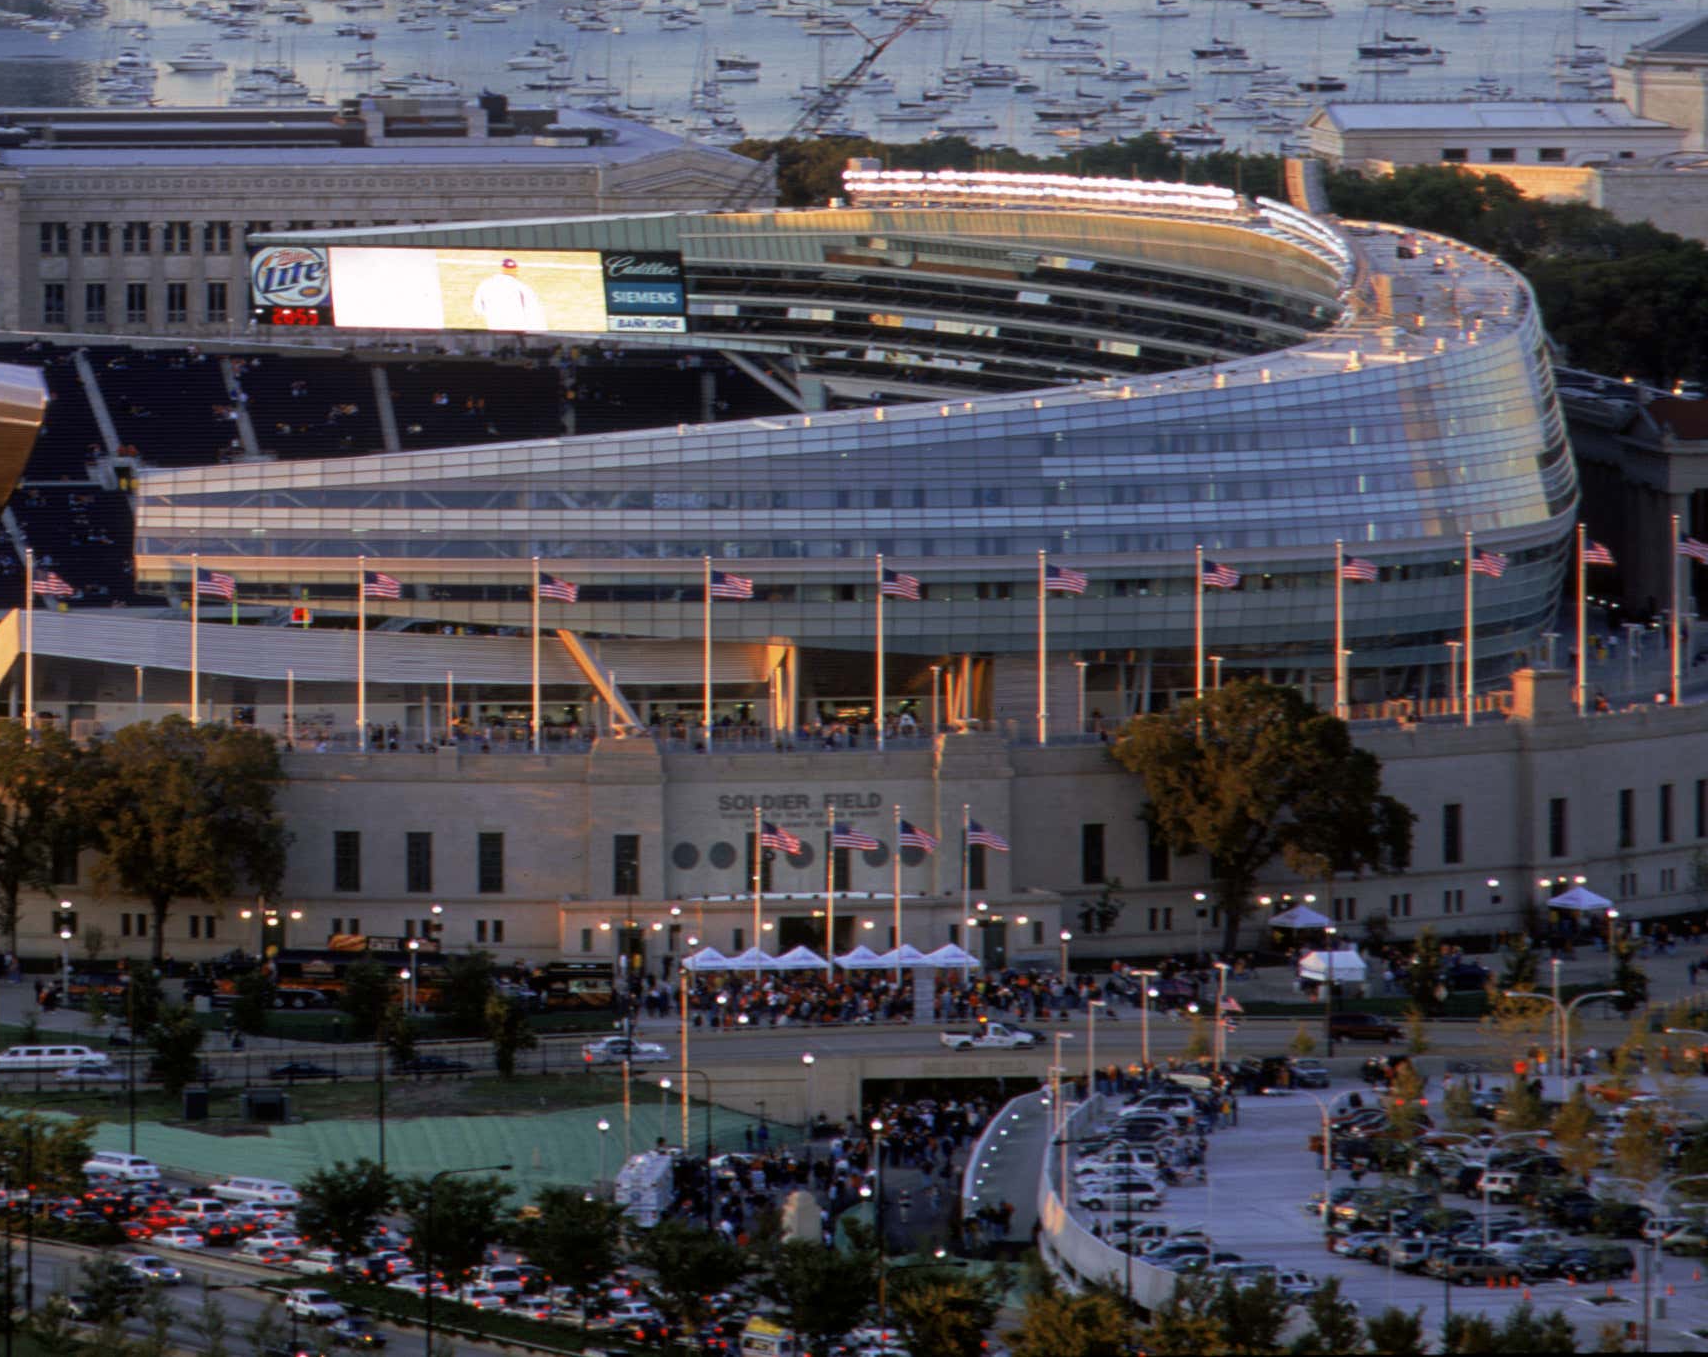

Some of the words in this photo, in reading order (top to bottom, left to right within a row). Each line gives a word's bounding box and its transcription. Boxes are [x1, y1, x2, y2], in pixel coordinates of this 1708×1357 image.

[604, 256, 679, 277] Cadillac
[261, 261, 325, 294] Lite
[612, 291, 677, 304] SIEMENS
[718, 793, 810, 811] SOLDIER
[824, 792, 882, 809] FIELD
